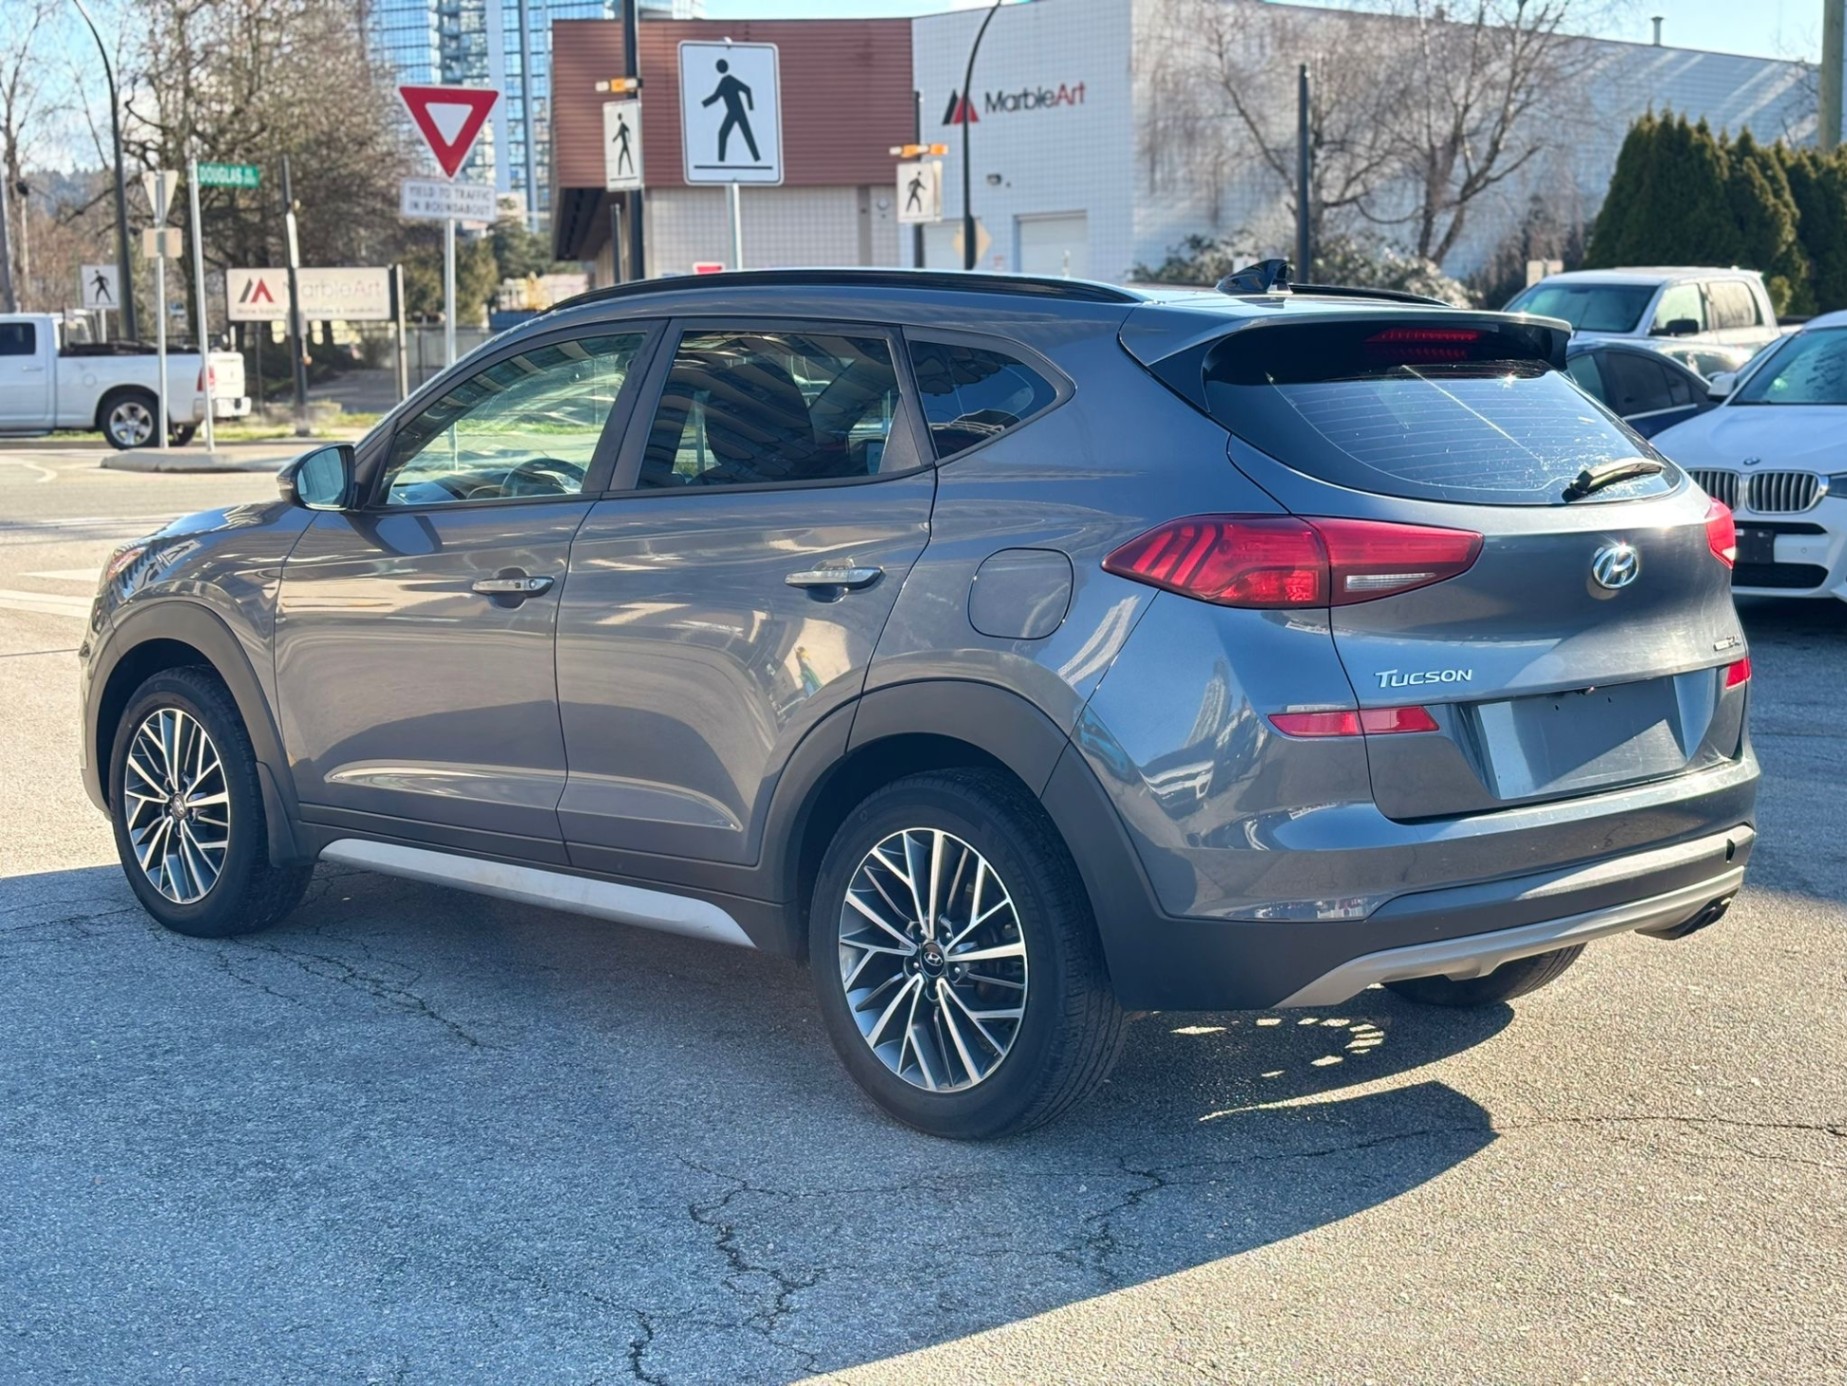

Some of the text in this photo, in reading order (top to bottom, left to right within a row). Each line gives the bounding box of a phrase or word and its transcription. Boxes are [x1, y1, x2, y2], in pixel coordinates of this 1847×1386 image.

[984, 81, 1086, 115] MarbleArt
[199, 165, 242, 184] DOUGLAS
[455, 188, 491, 201] TRAFFIC
[425, 202, 491, 216] ROUNDABOUT
